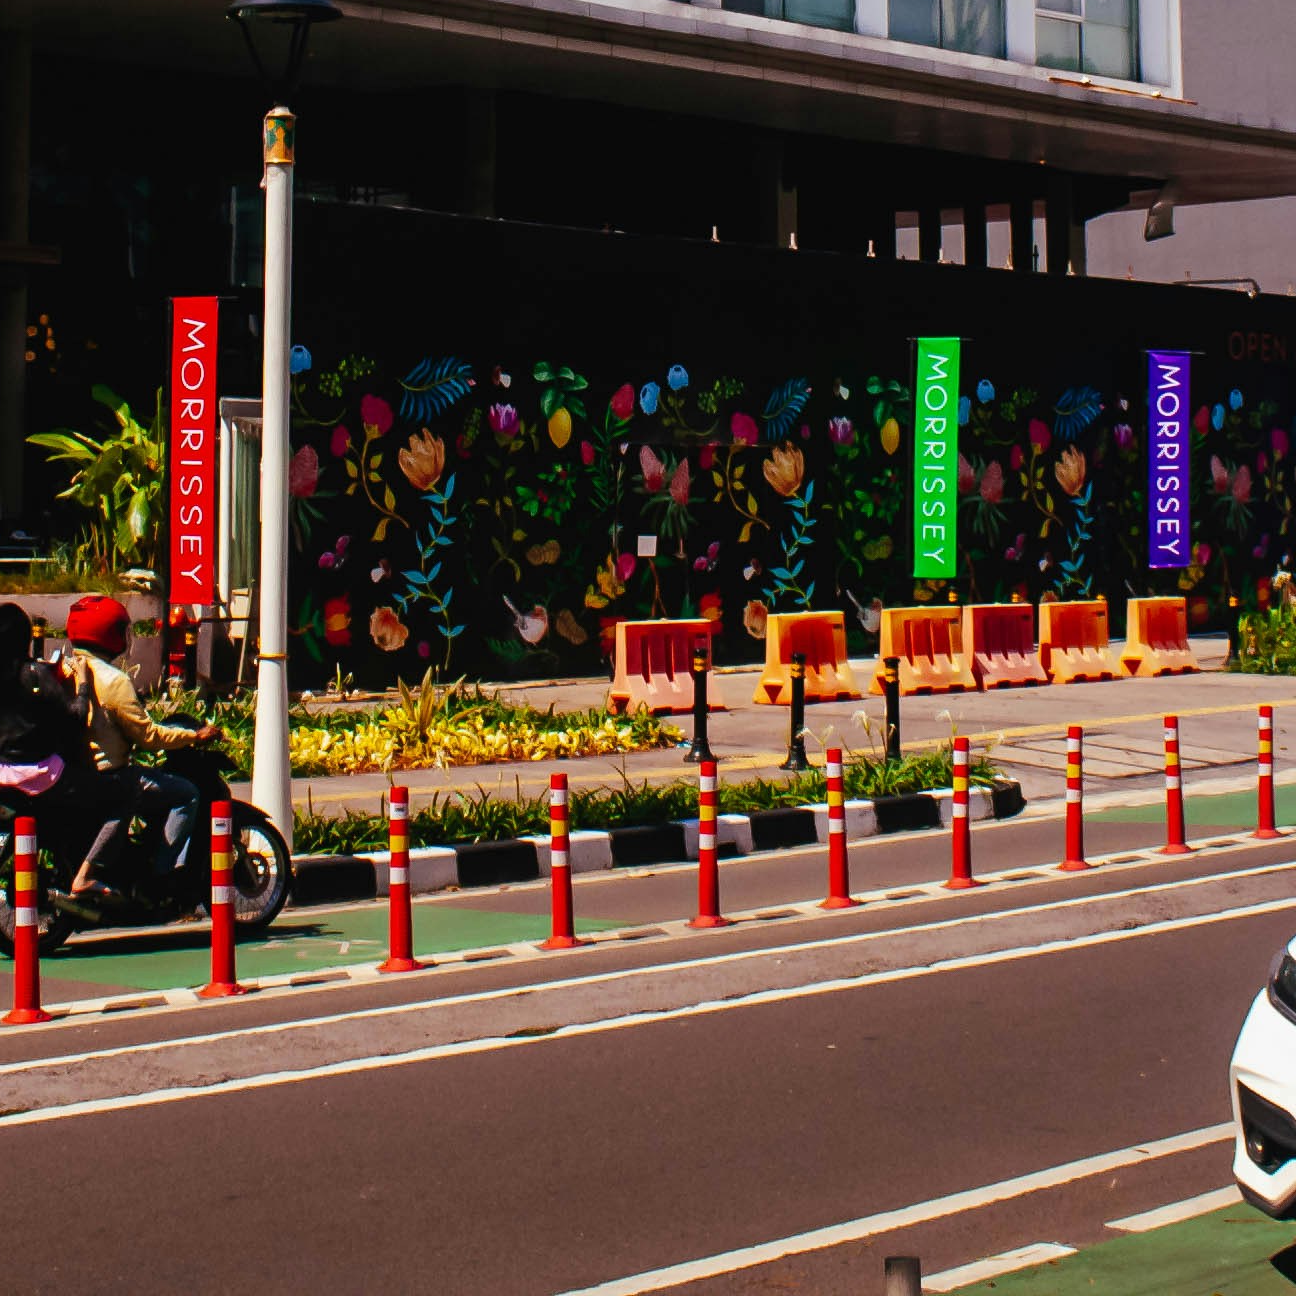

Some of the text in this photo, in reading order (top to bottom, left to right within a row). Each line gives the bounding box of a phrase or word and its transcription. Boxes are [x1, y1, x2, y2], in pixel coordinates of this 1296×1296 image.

[1228, 330, 1287, 361] OPEN
[179, 317, 207, 586] MORRISSEY
[922, 354, 949, 564] MORRISSEY
[1157, 364, 1181, 556] MORRISSEY
